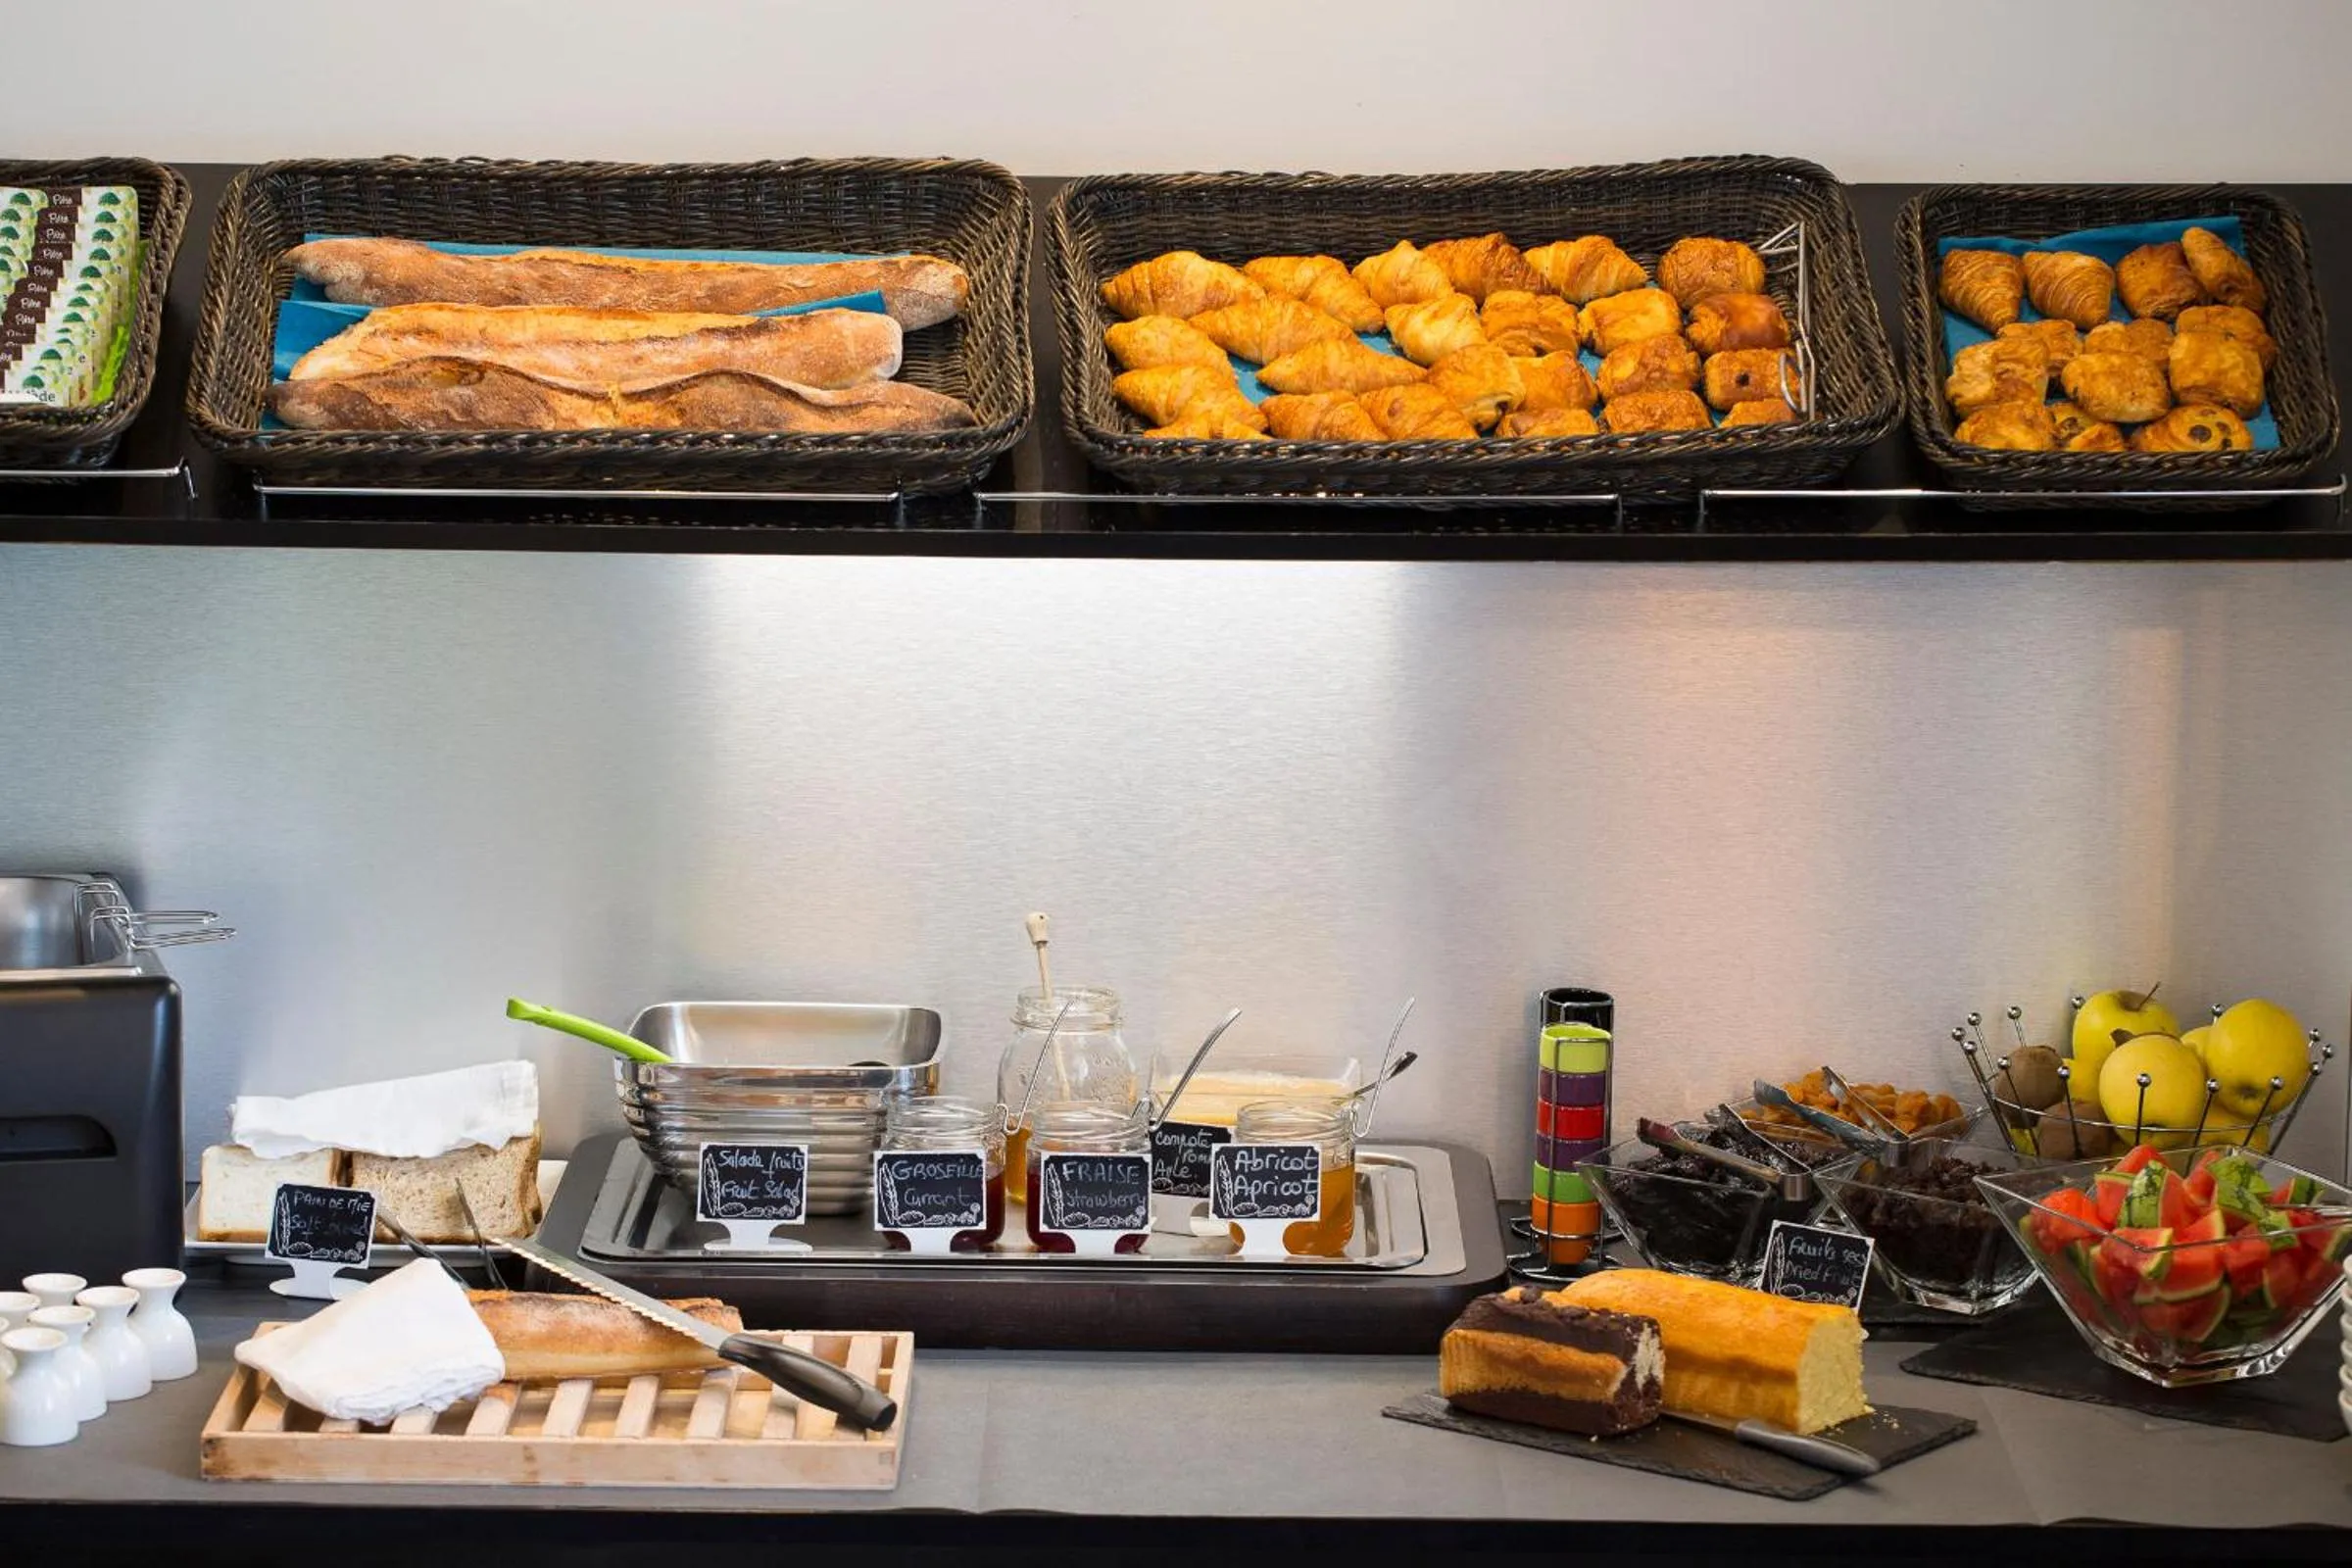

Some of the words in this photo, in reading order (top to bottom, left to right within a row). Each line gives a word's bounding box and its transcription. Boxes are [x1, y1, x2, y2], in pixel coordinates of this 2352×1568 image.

[718, 1149, 764, 1169] Salade
[761, 1151, 805, 1179] fruits
[1235, 1147, 1317, 1173] Abricot
[721, 1179, 761, 1200] Fruit
[763, 1178, 801, 1200] Salad
[904, 1186, 971, 1206] Currant
[1234, 1173, 1317, 1203] Apricot
[294, 1191, 325, 1207] PAIN
[328, 1198, 344, 1208] DE
[347, 1195, 371, 1214] MIE
[1788, 1236, 1837, 1260] Fruits
[1785, 1260, 1823, 1281] Dried
